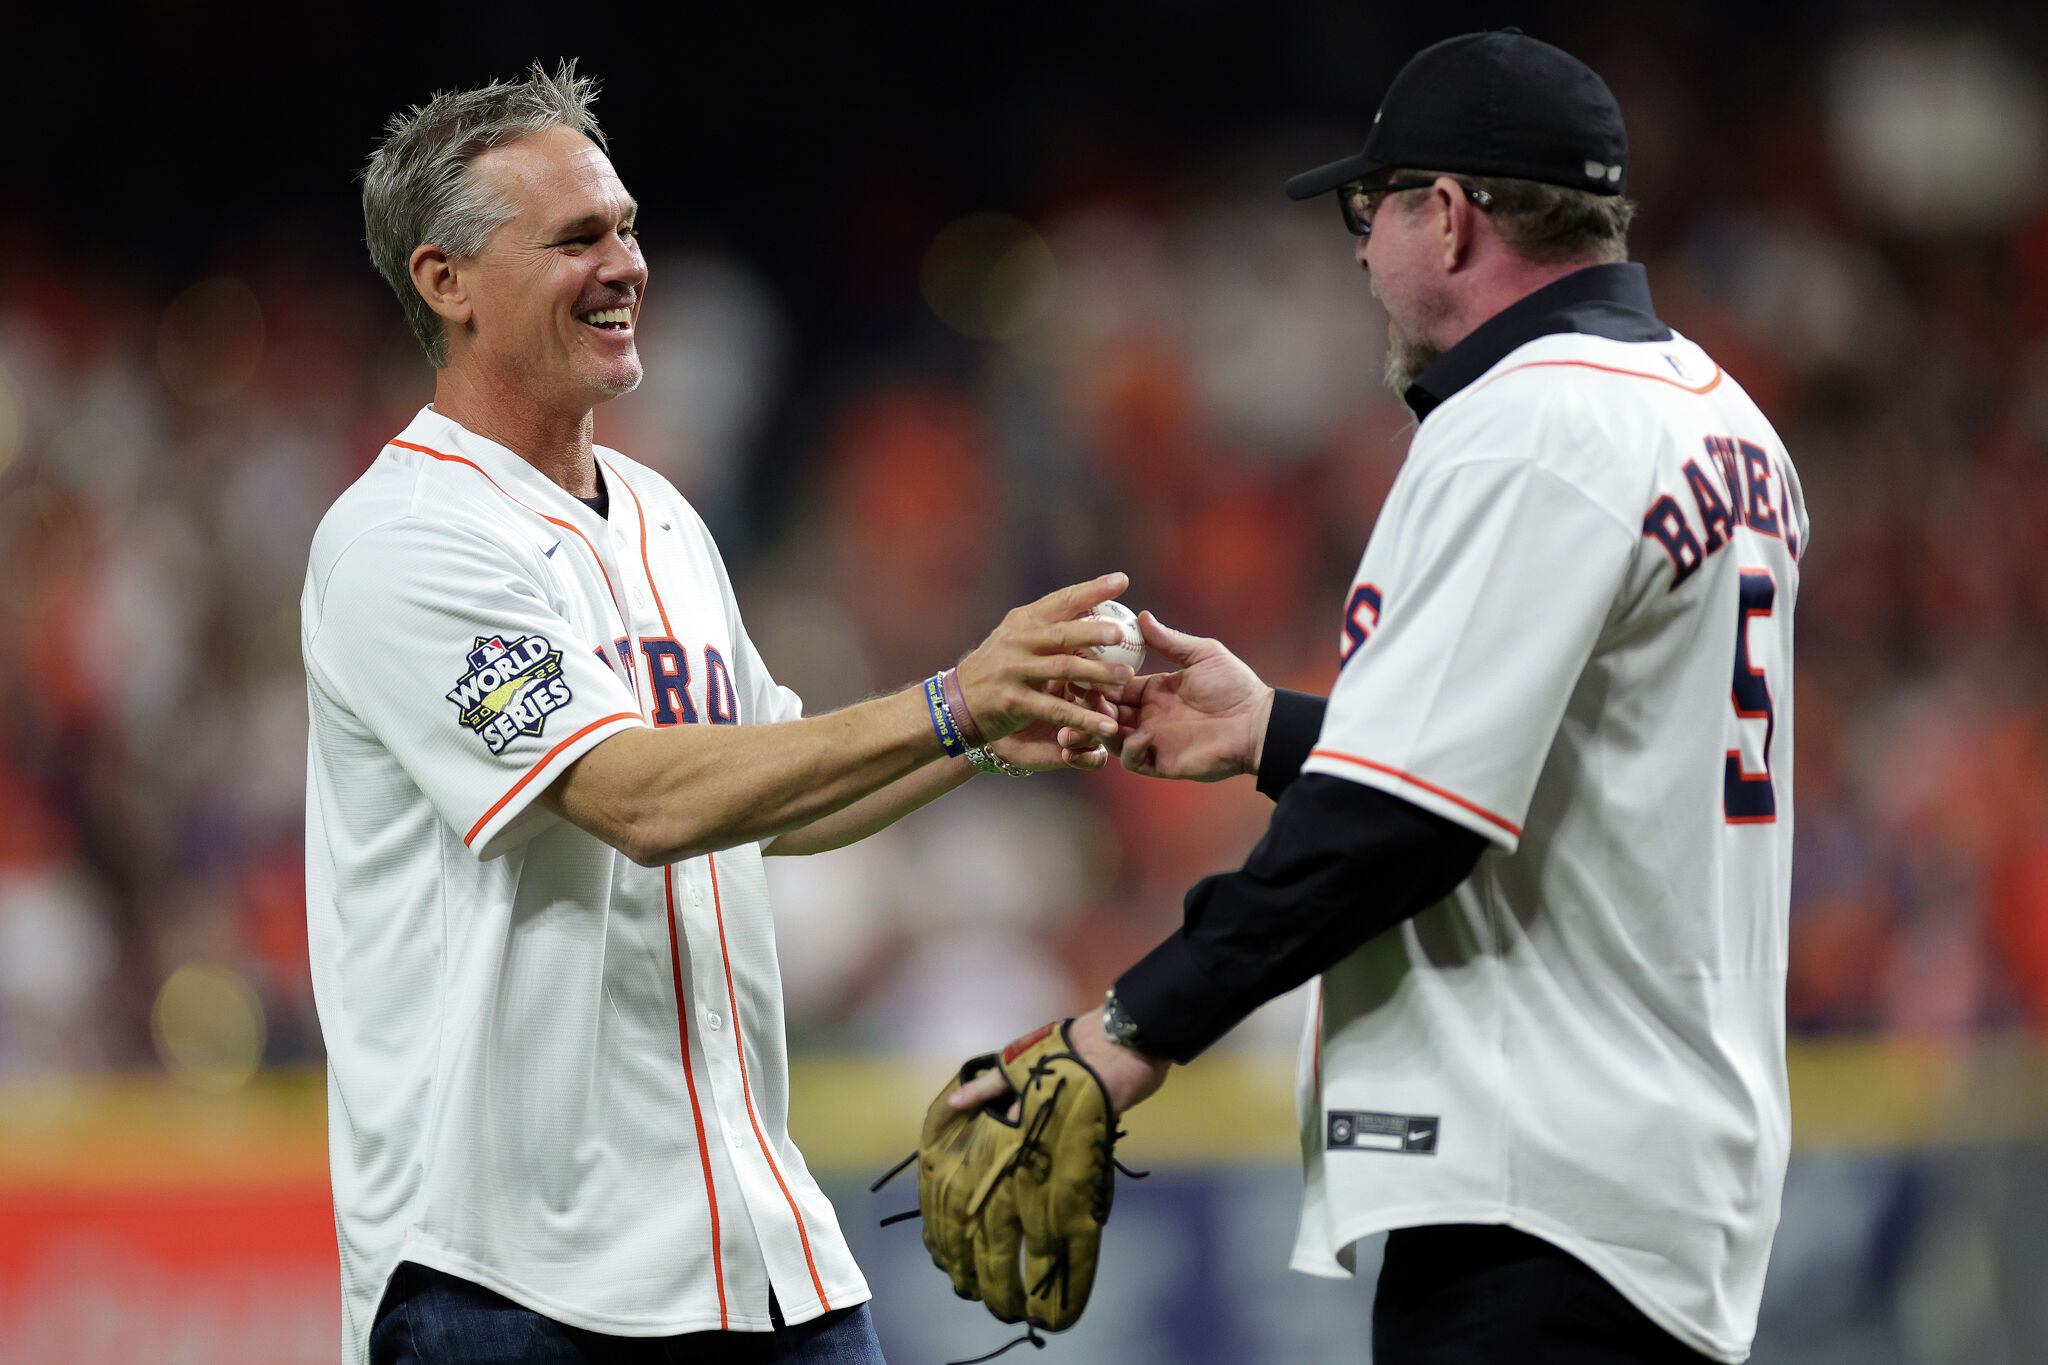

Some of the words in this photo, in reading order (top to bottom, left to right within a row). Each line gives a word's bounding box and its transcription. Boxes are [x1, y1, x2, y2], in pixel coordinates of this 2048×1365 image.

[448, 637, 550, 709] WORLD
[1724, 567, 1776, 824] 5
[483, 678, 571, 751] SERIES
